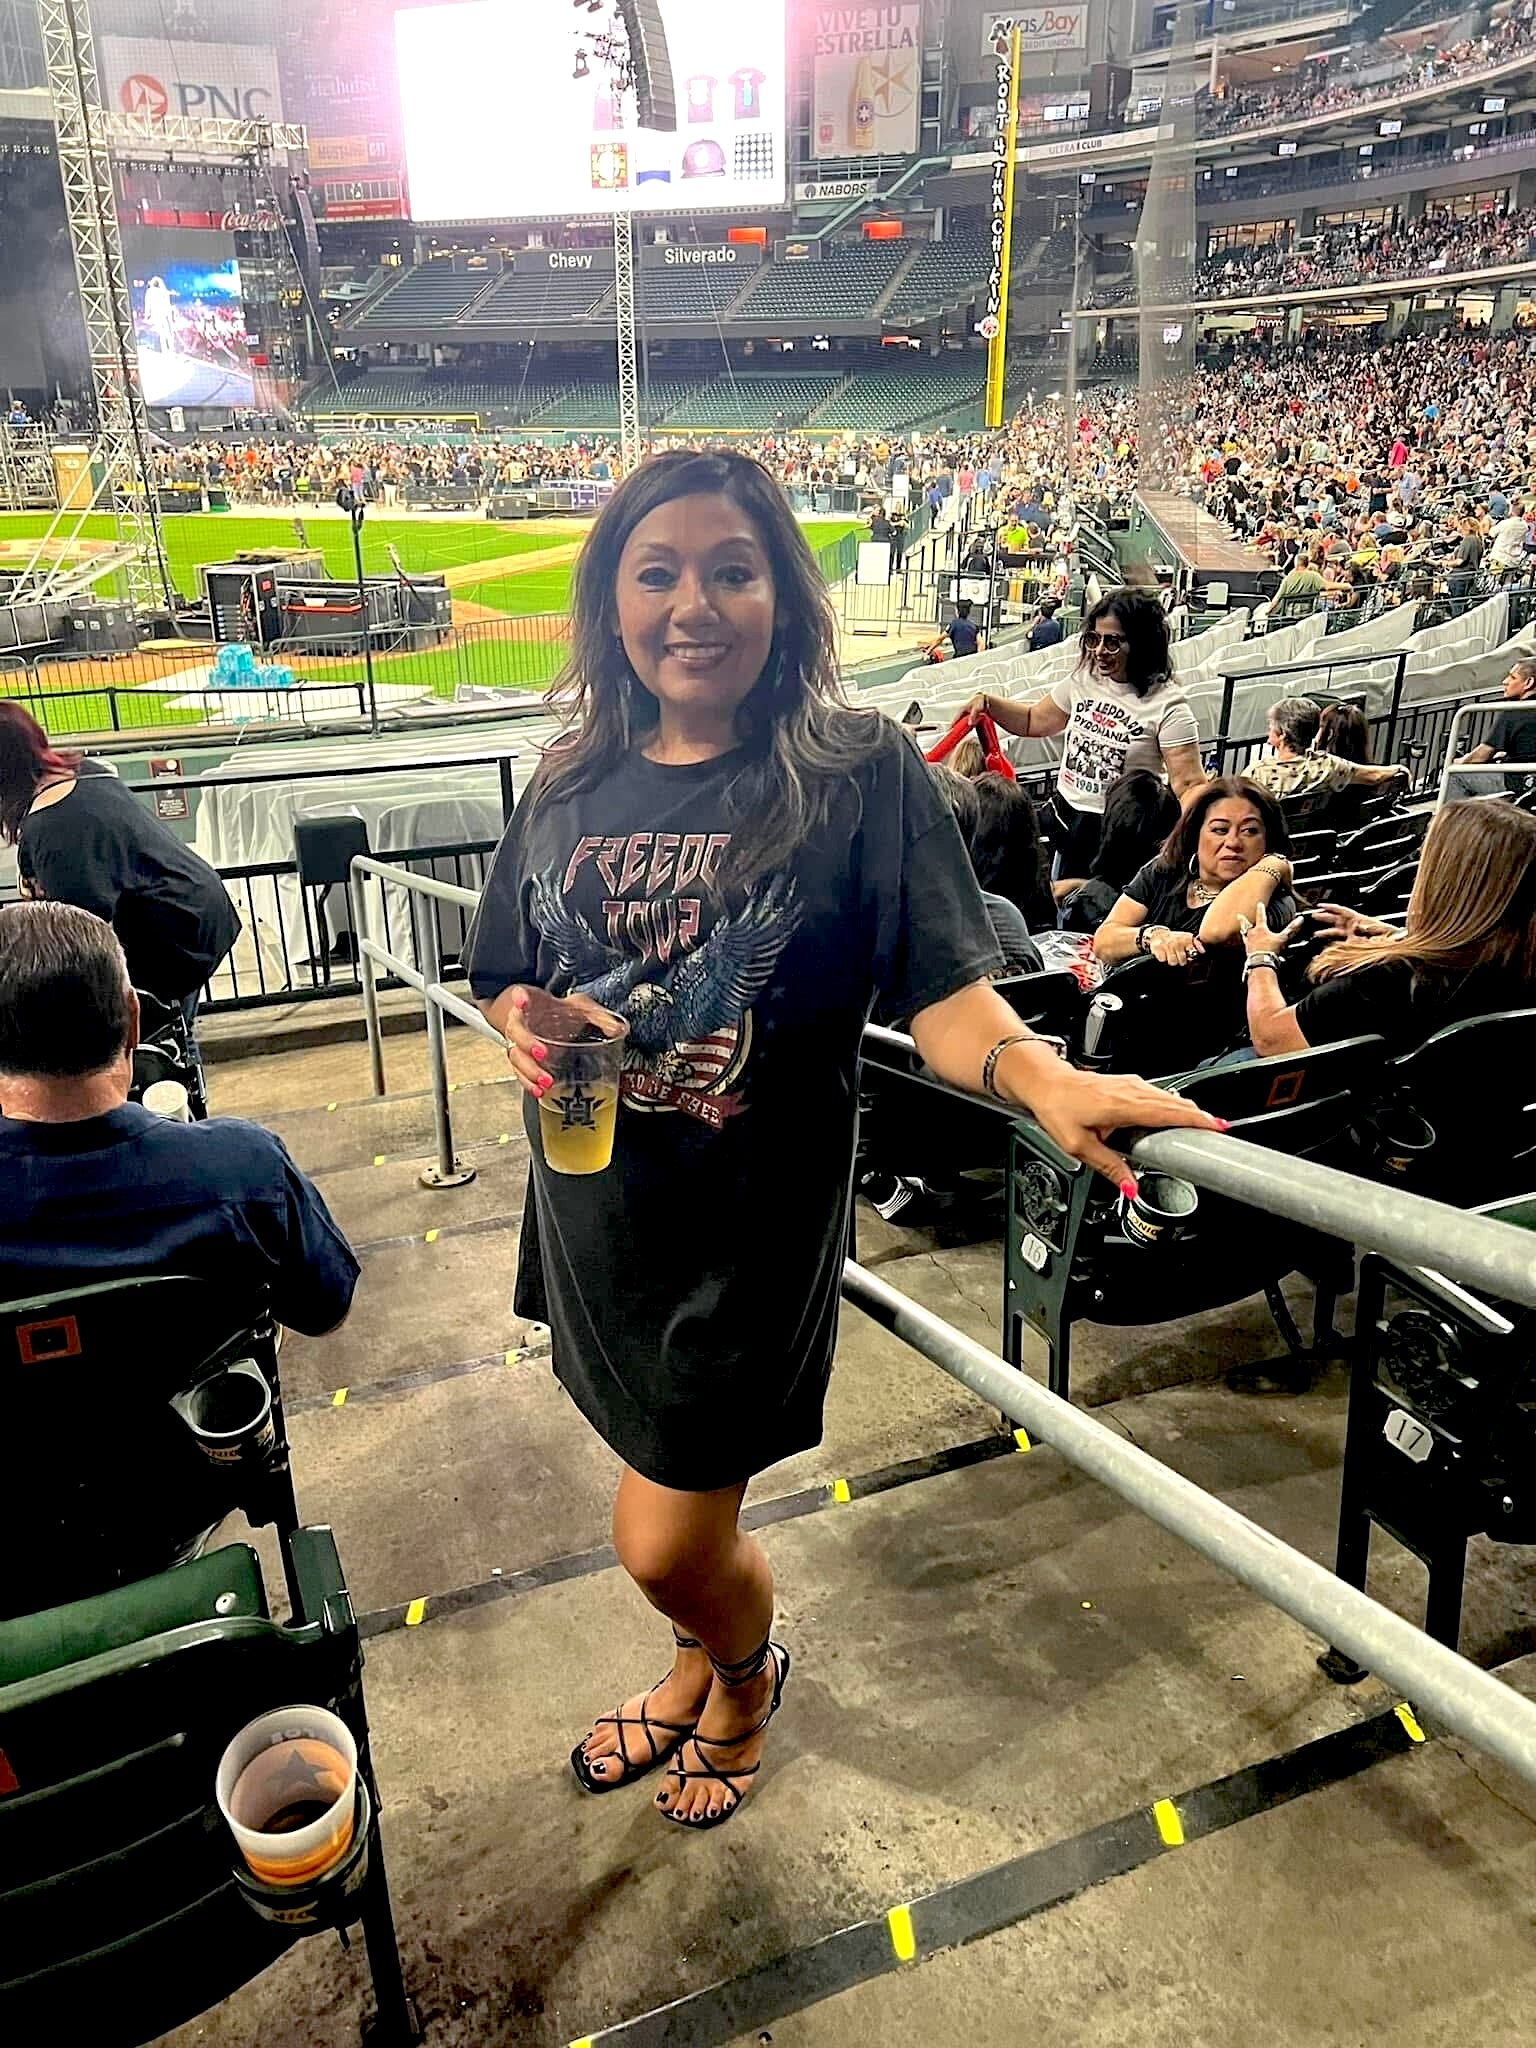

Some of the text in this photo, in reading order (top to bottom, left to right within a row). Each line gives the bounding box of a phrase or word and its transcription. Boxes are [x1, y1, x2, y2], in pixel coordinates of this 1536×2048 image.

[1044, 10, 1079, 35] Bay
[173, 84, 272, 121] PNC
[1081, 139, 1103, 151] CLUB
[819, 183, 867, 197] NABORS
[986, 64, 1011, 313] ROOT 4 THA CHIKIN
[549, 252, 593, 269] Chevy
[664, 245, 736, 264] Silverado
[563, 832, 731, 896] FREEDO
[602, 898, 701, 964] TOUR
[1027, 1239, 1043, 1264] 16
[1396, 1419, 1425, 1450] 17
